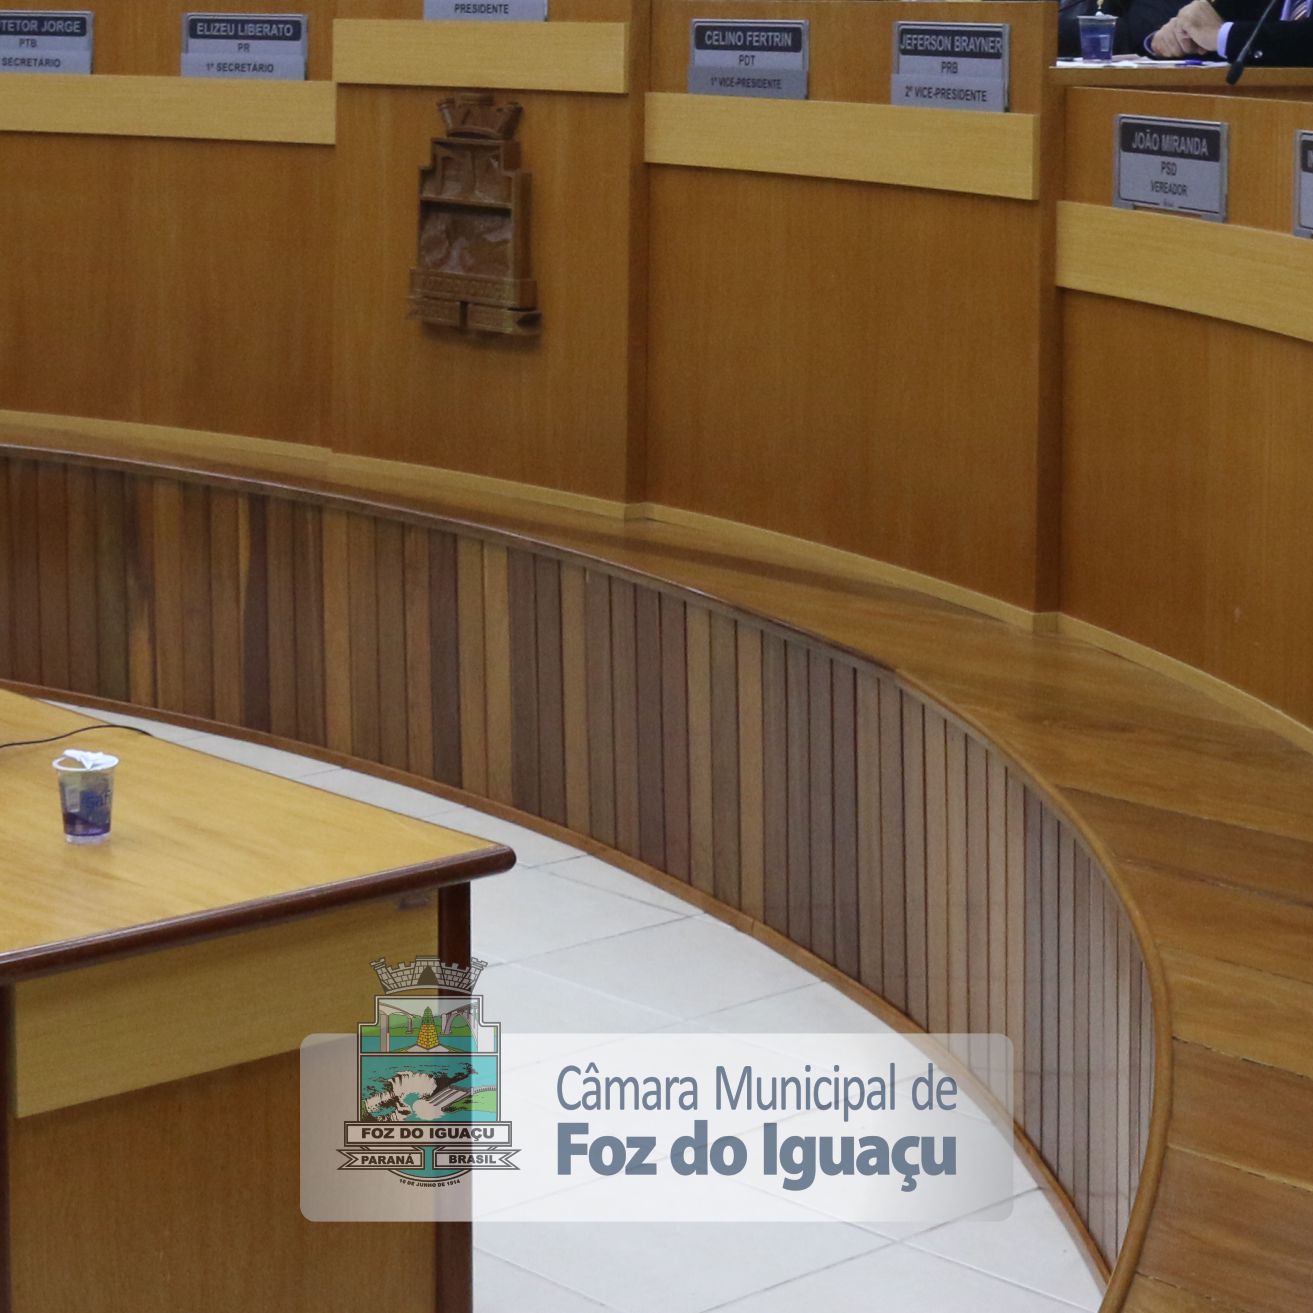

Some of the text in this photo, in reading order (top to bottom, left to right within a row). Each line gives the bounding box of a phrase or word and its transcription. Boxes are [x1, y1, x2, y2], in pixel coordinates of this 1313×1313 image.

[454, 4, 509, 14] PRESIDENTE
[41, 20, 80, 33] JORGE
[196, 23, 293, 36] ELIZEU LIBERATO
[19, 38, 37, 48] PTB
[704, 31, 792, 46] CELINO FERTRIN
[900, 34, 1002, 53] JEFERSON BRAYNER
[738, 55, 756, 66] PDT
[941, 62, 958, 74] PRB
[1132, 129, 1208, 156] JOÃO MIRANDA
